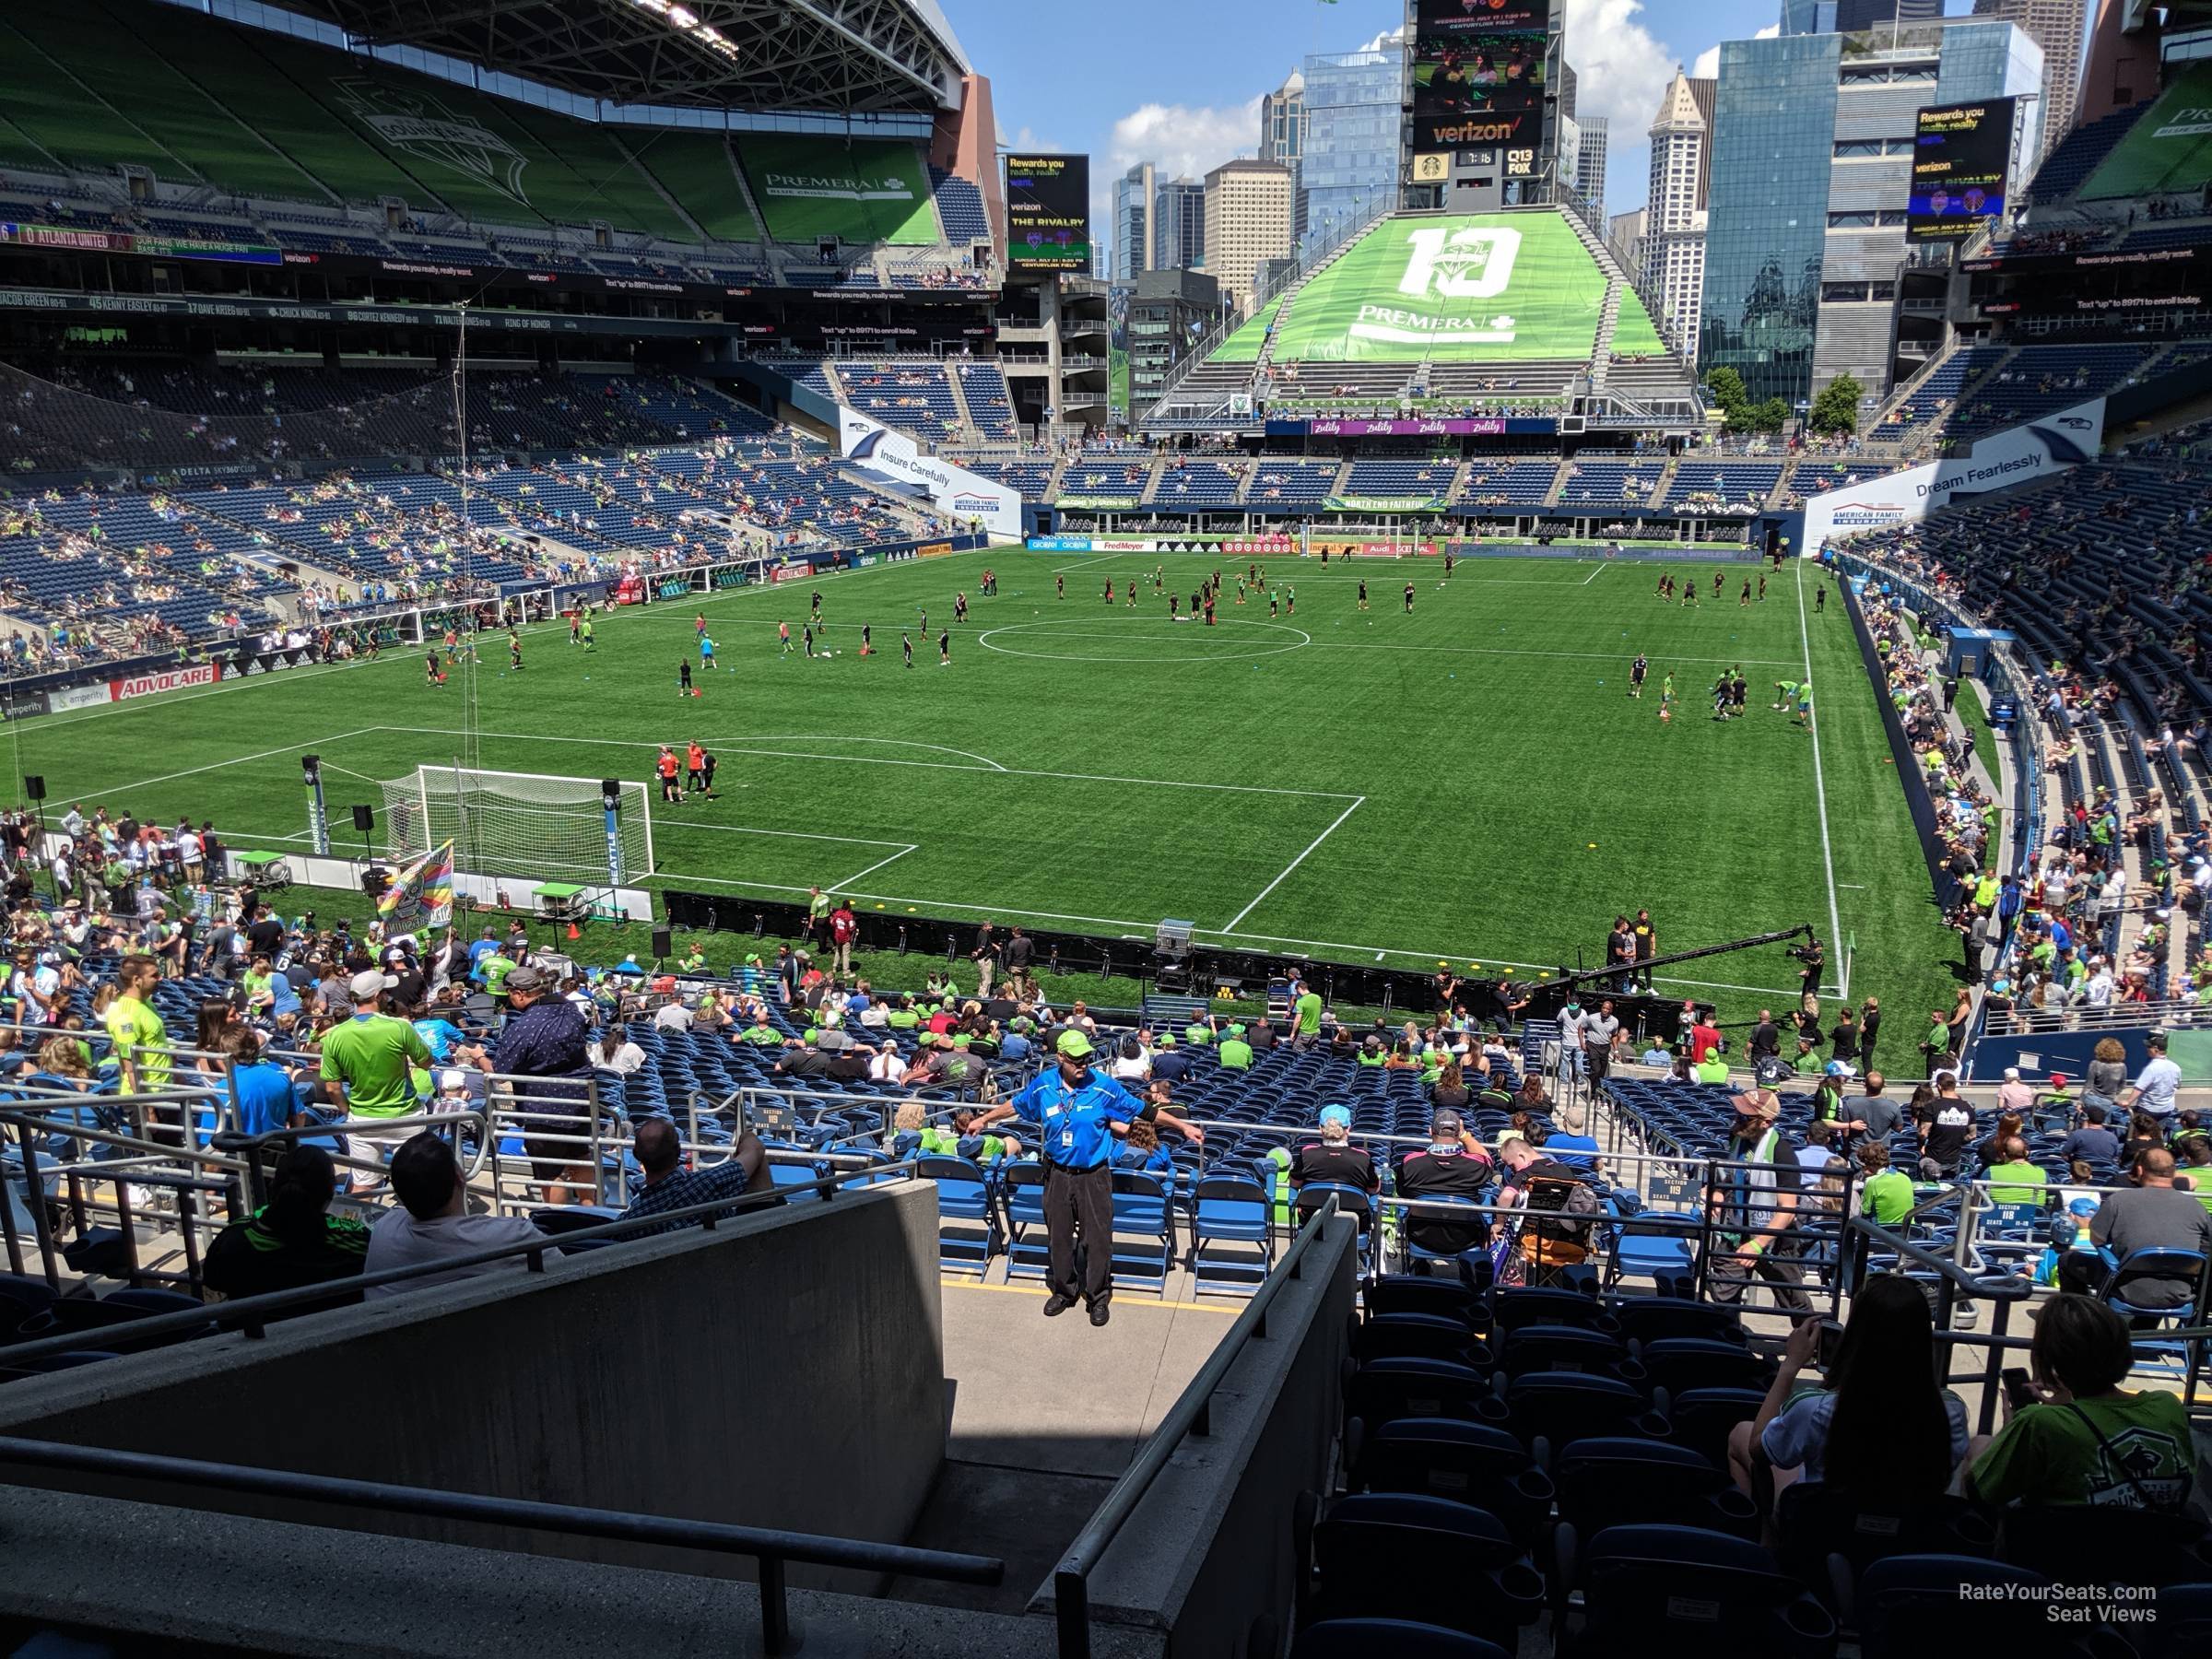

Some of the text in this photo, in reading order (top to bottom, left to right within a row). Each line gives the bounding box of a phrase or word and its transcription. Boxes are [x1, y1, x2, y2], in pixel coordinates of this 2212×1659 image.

[1920, 108, 1984, 123] Rewards you
[1949, 118, 1978, 130] really
[1433, 121, 1512, 143] verizon
[1468, 152, 1491, 163] 7:16
[1508, 148, 1534, 162] Q13
[1010, 159, 1065, 170] Rewards you
[1508, 162, 1532, 174] FOX
[1915, 161, 1952, 173] verizon
[766, 173, 872, 189] PREMERA
[1945, 173, 2002, 185] RIVALRY
[1011, 203, 1041, 211] verizon
[27, 228, 35, 242] 0
[39, 230, 79, 247] ATLANTA
[78, 233, 109, 249] UNITED
[136, 236, 154, 246] OUR
[175, 241, 187, 250] WE
[189, 241, 207, 251] HAVE
[232, 244, 249, 254] FAN
[284, 253, 312, 265] verizon
[2076, 250, 2194, 265] Rewards you really, really want.
[382, 261, 410, 272] Rewards
[410, 265, 422, 275] you
[421, 265, 440, 276] really,
[440, 267, 456, 277] really
[1963, 263, 1992, 271] verizon
[527, 274, 550, 282] verizon
[605, 278, 617, 287] Text
[628, 280, 634, 288] to
[649, 282, 655, 290] to
[654, 283, 669, 291] enroll
[726, 288, 746, 296] verizon
[812, 290, 841, 300] Rewards
[841, 292, 852, 301] you
[852, 291, 872, 301] really,
[871, 292, 888, 301] really
[966, 292, 990, 300] verizon
[25, 295, 50, 307] GREEN
[89, 295, 153, 312] 45 KENNY EASLEY
[2077, 296, 2201, 311] Text "up" to 89171 to enroll today.
[187, 302, 236, 316] 17 DAVE KRIEG
[279, 307, 318, 319] CHUCK KNOX
[1984, 304, 2012, 312] verizon
[358, 311, 380, 322] CORTEZ
[380, 312, 406, 323] KENNEDY
[1357, 304, 1477, 330] PREMERA
[505, 318, 551, 330] RING OF HONOR
[743, 325, 767, 334] verizon
[820, 326, 835, 335] Text
[834, 326, 849, 336] "up"
[898, 328, 918, 338] today.
[181, 467, 211, 476] DELTA
[880, 449, 951, 488] Insure Carefully
[1916, 451, 2042, 499] Dream Fearlessly
[1059, 499, 1134, 507] WELCOME TO GREEN HELL
[1345, 500, 1425, 508] NORTH END FAITHFUL
[1833, 511, 1903, 519] AMERICAN FAMILY
[777, 566, 809, 581] ADVOCARE
[120, 666, 213, 698] ADVOCARE
[69, 689, 104, 704] amperity
[6, 701, 43, 717] amperity
[607, 831, 619, 886] SEATTLE
[276, 956, 290, 971] 13
[488, 967, 498, 980] 6
[768, 1114, 778, 1124] 119
[1669, 1185, 1681, 1195] 119
[2002, 1210, 2015, 1220] 118
[2117, 1483, 2172, 1495] SETTLE
